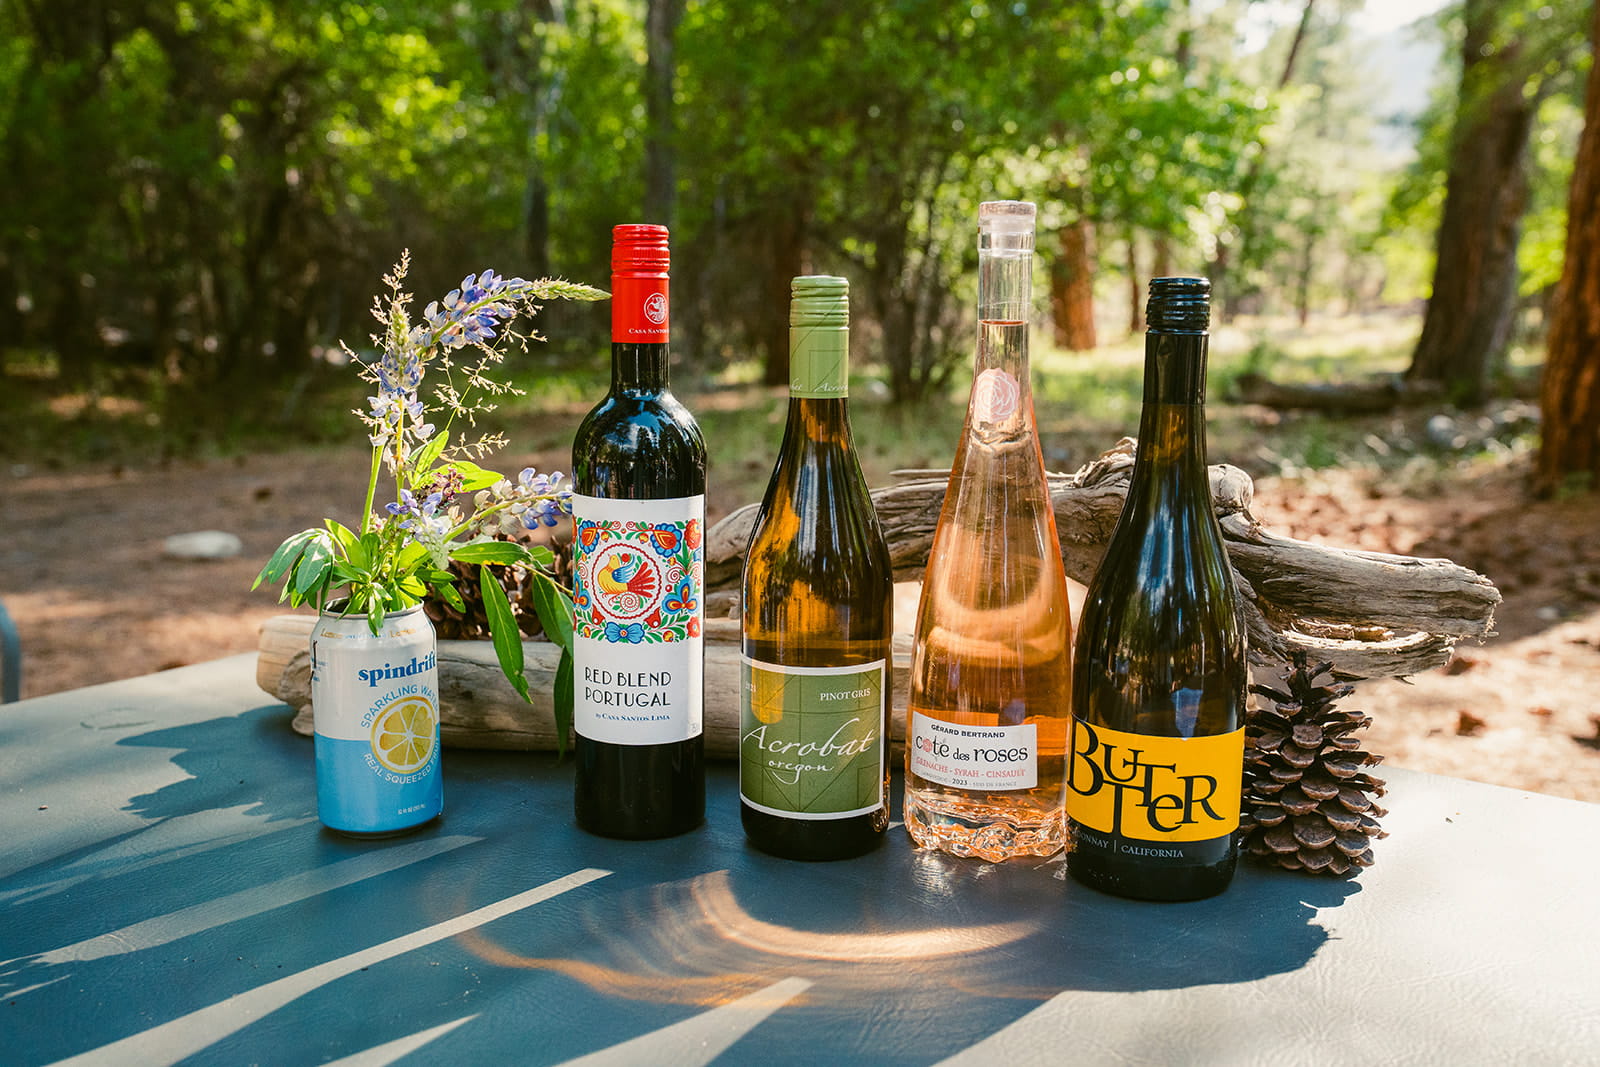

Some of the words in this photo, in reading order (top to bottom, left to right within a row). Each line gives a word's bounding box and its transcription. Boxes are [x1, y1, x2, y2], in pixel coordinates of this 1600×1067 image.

[358, 651, 436, 687] spindrift
[585, 666, 612, 685] RED
[617, 671, 671, 687] BLEND
[585, 686, 671, 707] PORTUGAL
[820, 691, 850, 701] PINOT
[851, 688, 871, 699] GRIS
[361, 684, 418, 728] SPARKLING
[743, 717, 875, 757] Acrobat
[961, 730, 1005, 738] BERTRAND
[952, 747, 970, 761] des
[973, 746, 1028, 762] roses
[363, 752, 383, 777] REAL
[384, 765, 432, 784] SQUEEZED
[768, 759, 834, 785] oregon
[953, 767, 979, 777] SYRAH
[986, 768, 1026, 778] CINSAULT
[1121, 845, 1184, 858] CALIFORNIA
